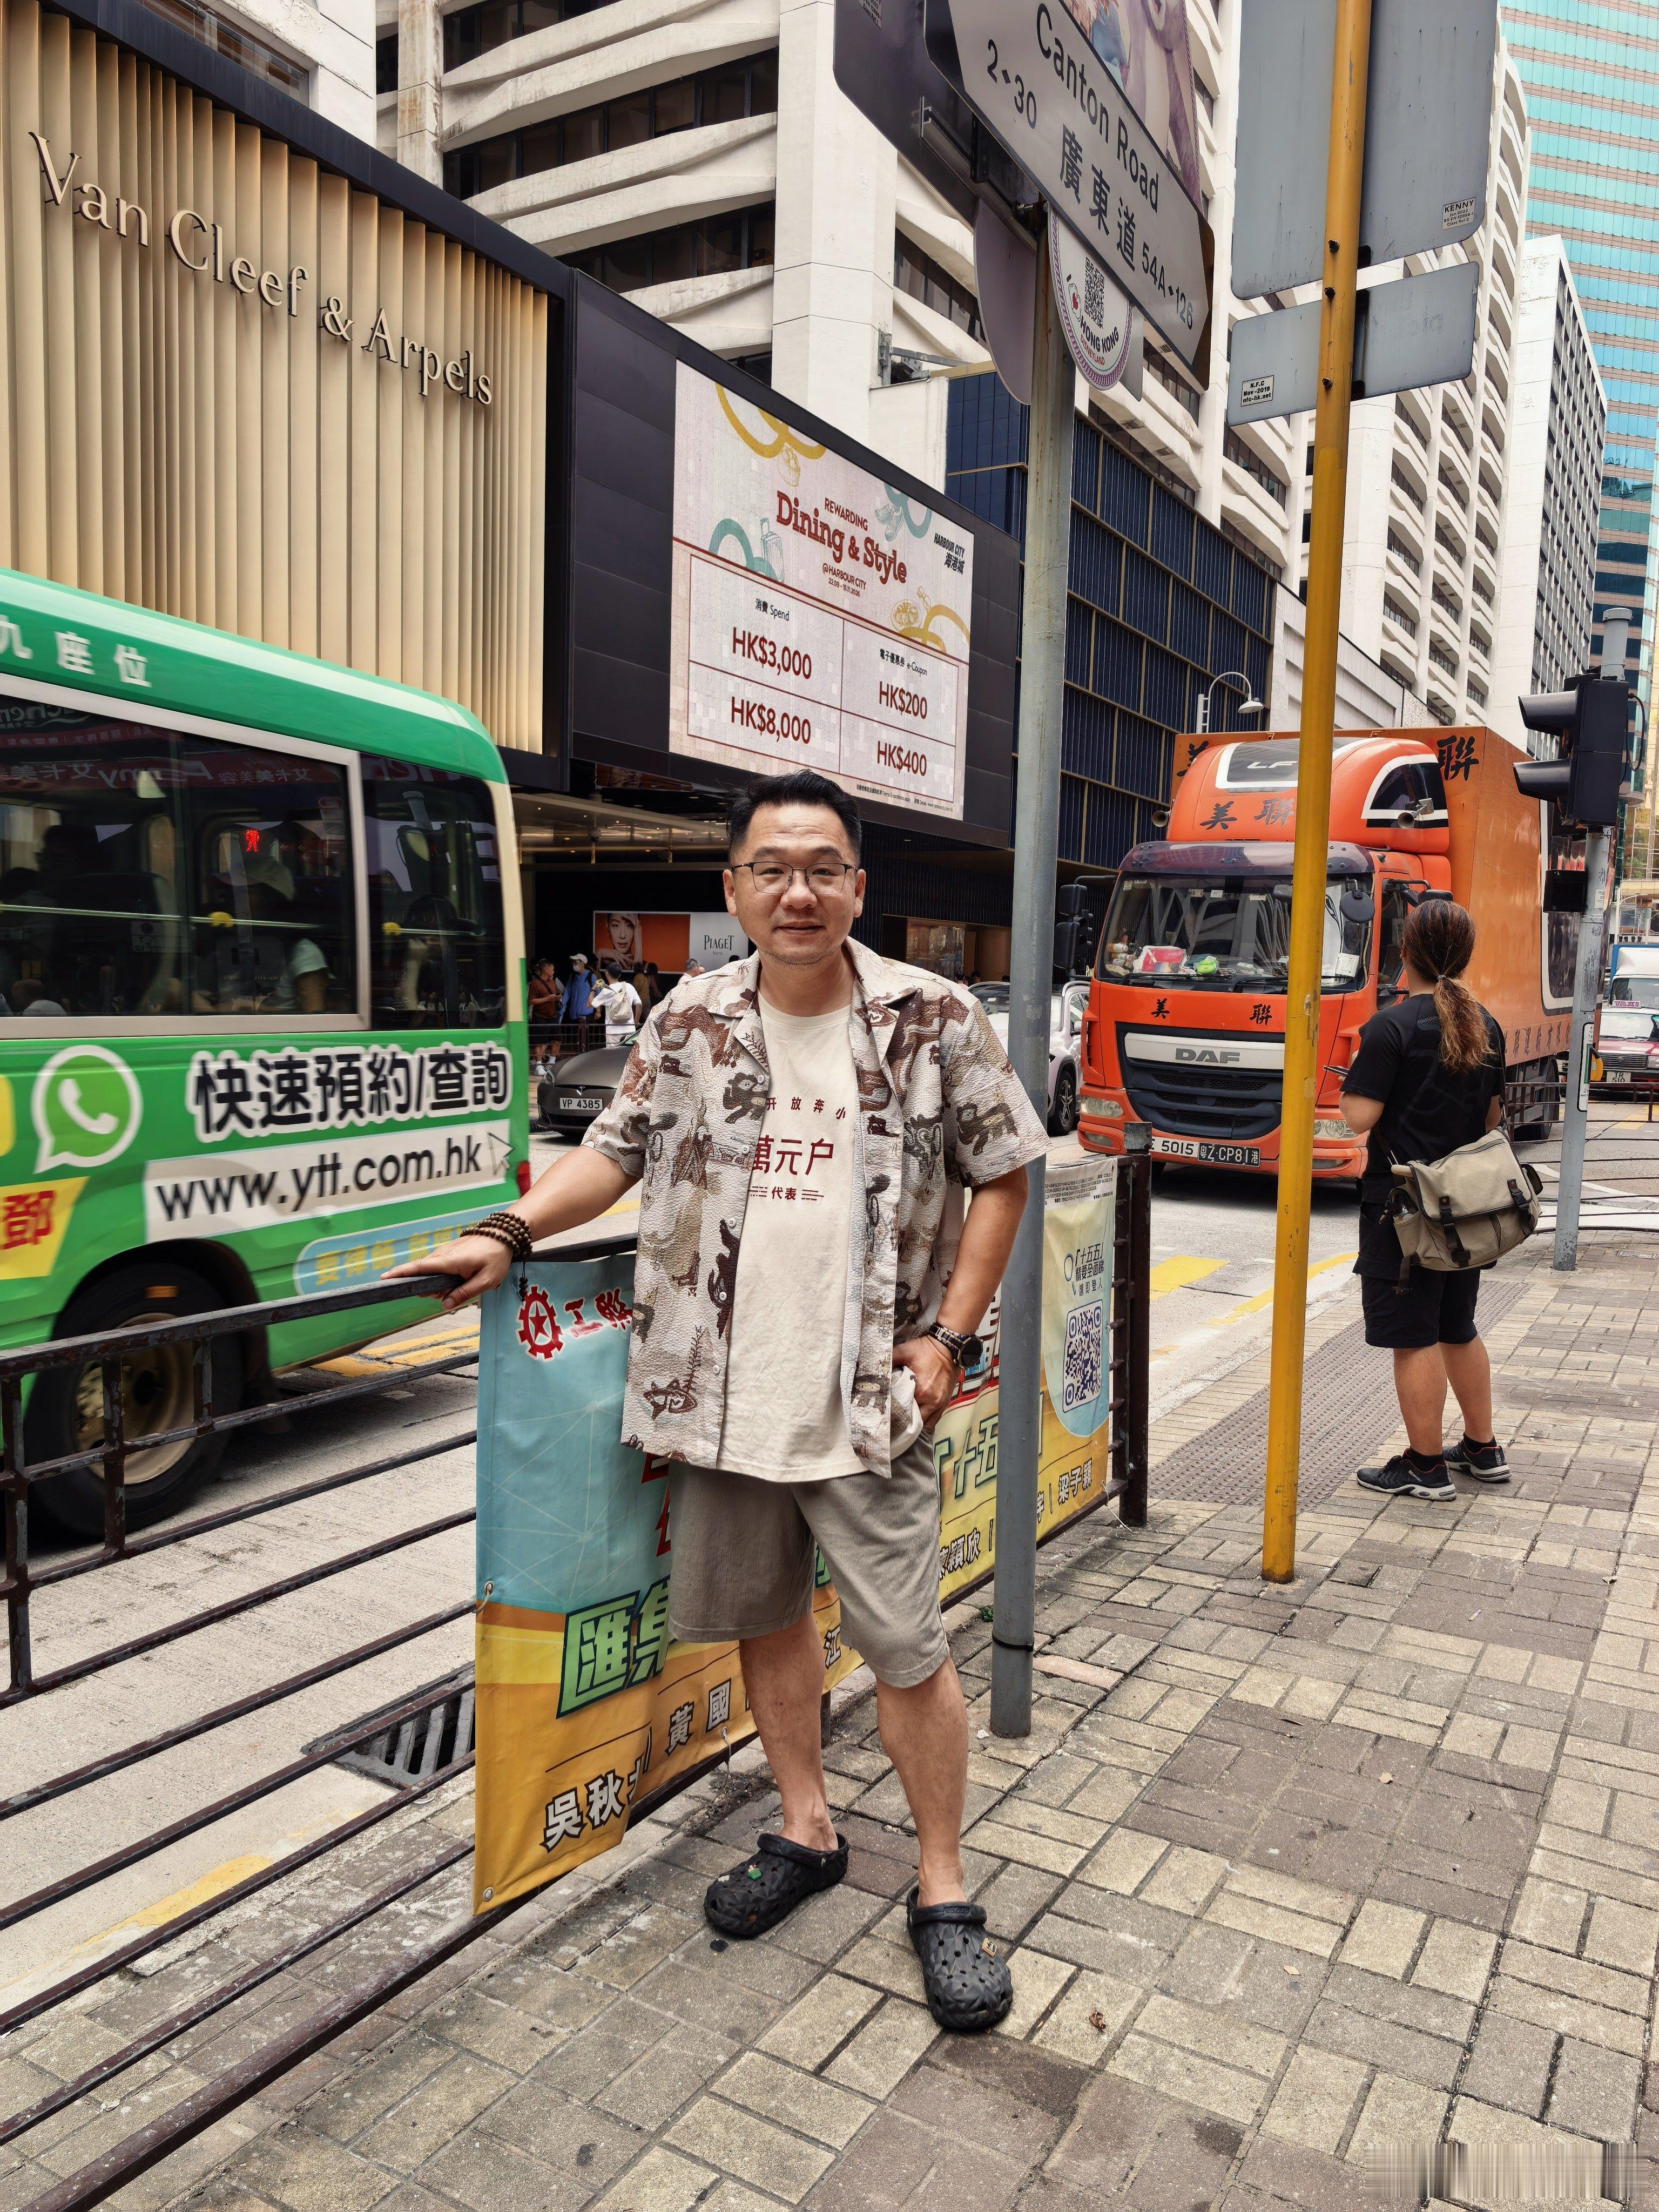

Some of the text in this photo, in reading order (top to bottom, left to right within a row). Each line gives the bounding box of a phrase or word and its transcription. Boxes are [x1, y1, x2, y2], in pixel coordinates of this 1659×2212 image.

[1036, 3, 1159, 214] Canton Road
[1060, 123, 1136, 272] 廣東道
[1445, 199, 1474, 213] KENNY
[28, 131, 493, 406] Van Cleef & Arpels
[1081, 315, 1119, 354] HONG KONG
[1081, 334, 1105, 366] DISNEYLAND
[1243, 393, 1271, 403] nfc-hk.net
[825, 497, 868, 531] REWARDING
[777, 490, 907, 585] Dining & Style
[934, 532, 965, 558] HARBOUR CITY
[943, 551, 965, 575] 海港城
[855, 577, 867, 590] CITY
[770, 604, 790, 622] Spend
[0, 615, 153, 688] 九座位
[732, 626, 812, 679] HK$3,000
[907, 662, 928, 678] e-Coupon
[879, 680, 928, 719] HK$200
[731, 696, 811, 744] HK$8,000
[877, 740, 927, 777] HK$400
[704, 935, 734, 950] PIAGET
[1175, 1048, 1240, 1064] DAF
[193, 1044, 510, 1136] 快速預約/查詢
[562, 1099, 601, 1109] VP 4385
[1161, 1140, 1195, 1155] 5015
[156, 1135, 482, 1222] www.ytt.com.hk
[771, 1186, 797, 1201] 代表
[1079, 1277, 1103, 1297] 請即登入
